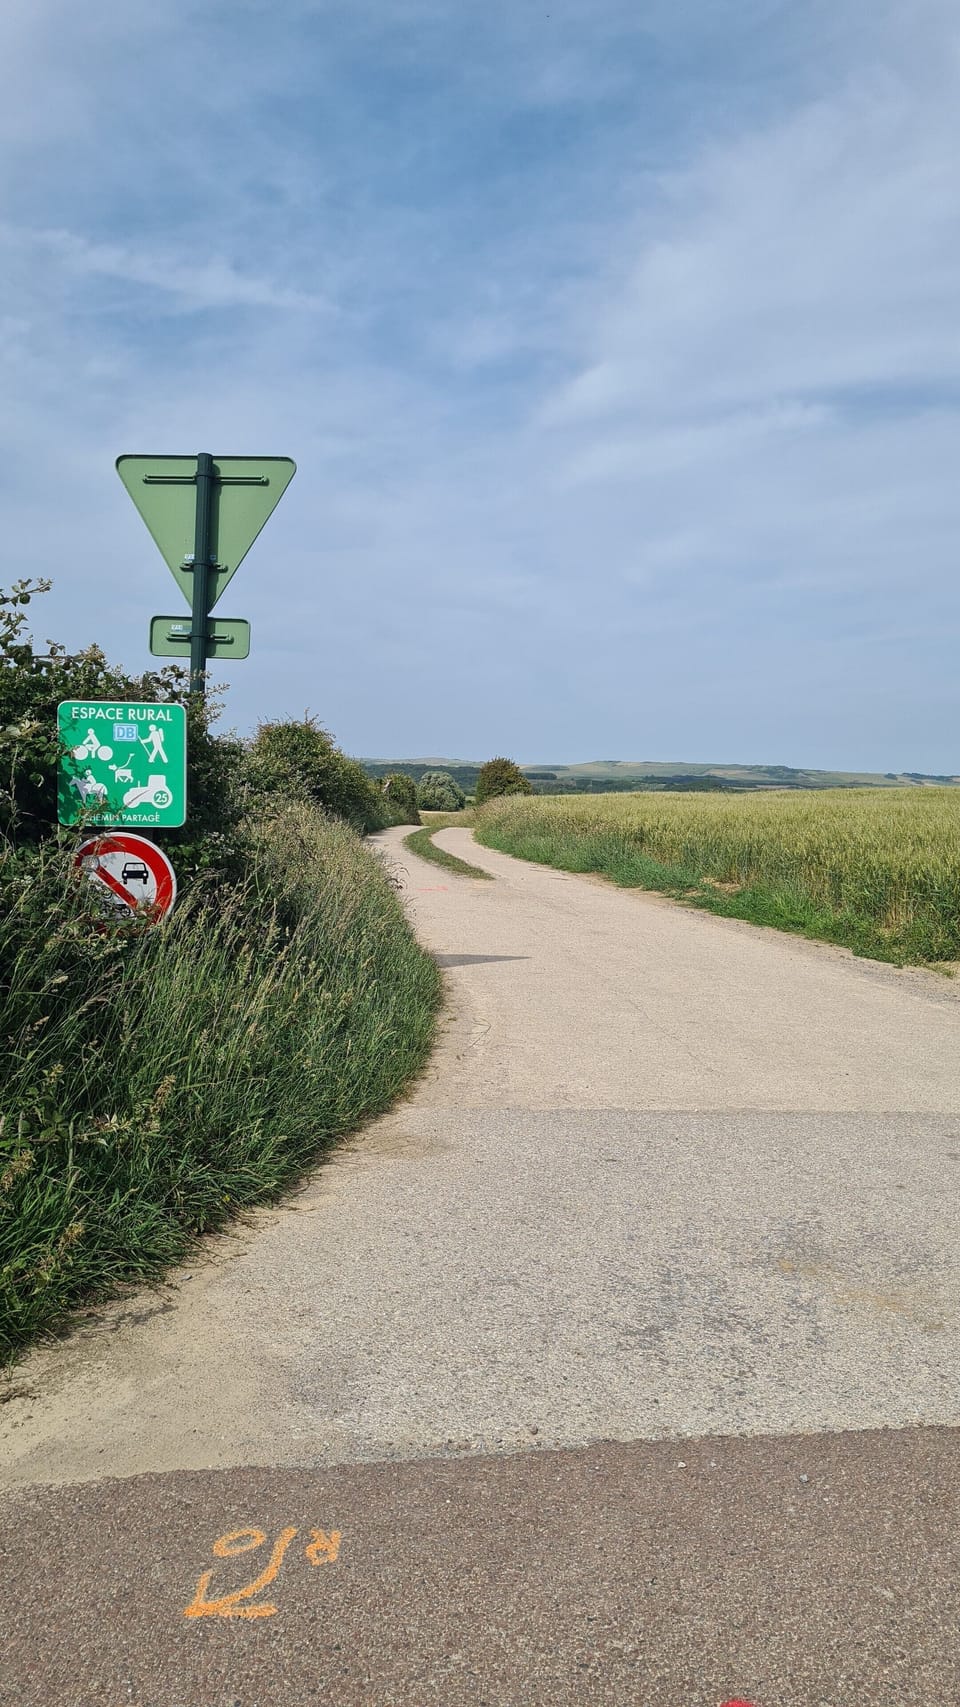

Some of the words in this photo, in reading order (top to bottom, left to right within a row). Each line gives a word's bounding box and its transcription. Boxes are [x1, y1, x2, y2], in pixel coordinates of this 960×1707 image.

[71, 706, 124, 720] ESPACE
[128, 708, 173, 721] RURAL
[116, 726, 135, 739] DB
[155, 793, 168, 803] 25
[121, 811, 160, 823] PARTAGÉ
